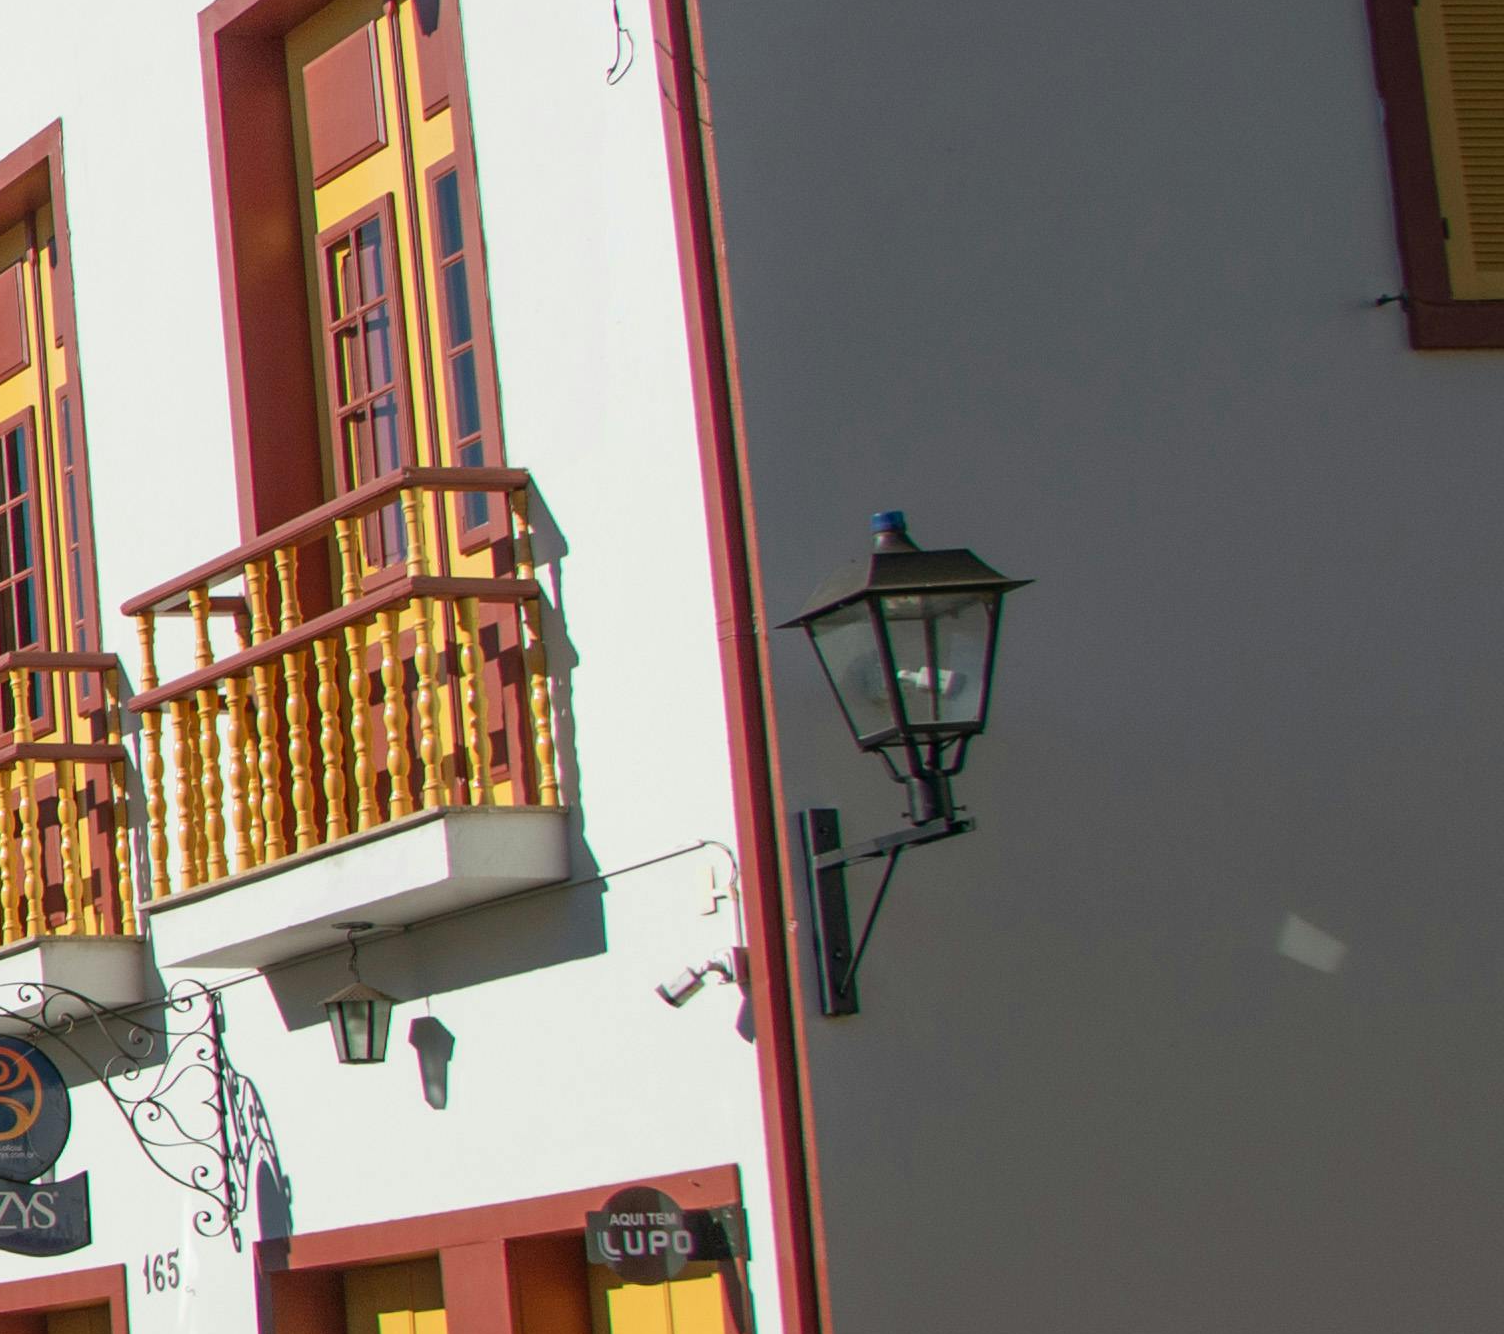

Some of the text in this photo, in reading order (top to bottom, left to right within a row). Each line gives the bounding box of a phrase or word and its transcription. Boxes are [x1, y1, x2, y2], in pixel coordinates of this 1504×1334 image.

[609, 1212, 677, 1226] AQUI TEM
[597, 1229, 694, 1261] LUPO
[142, 1248, 181, 1295] 165
